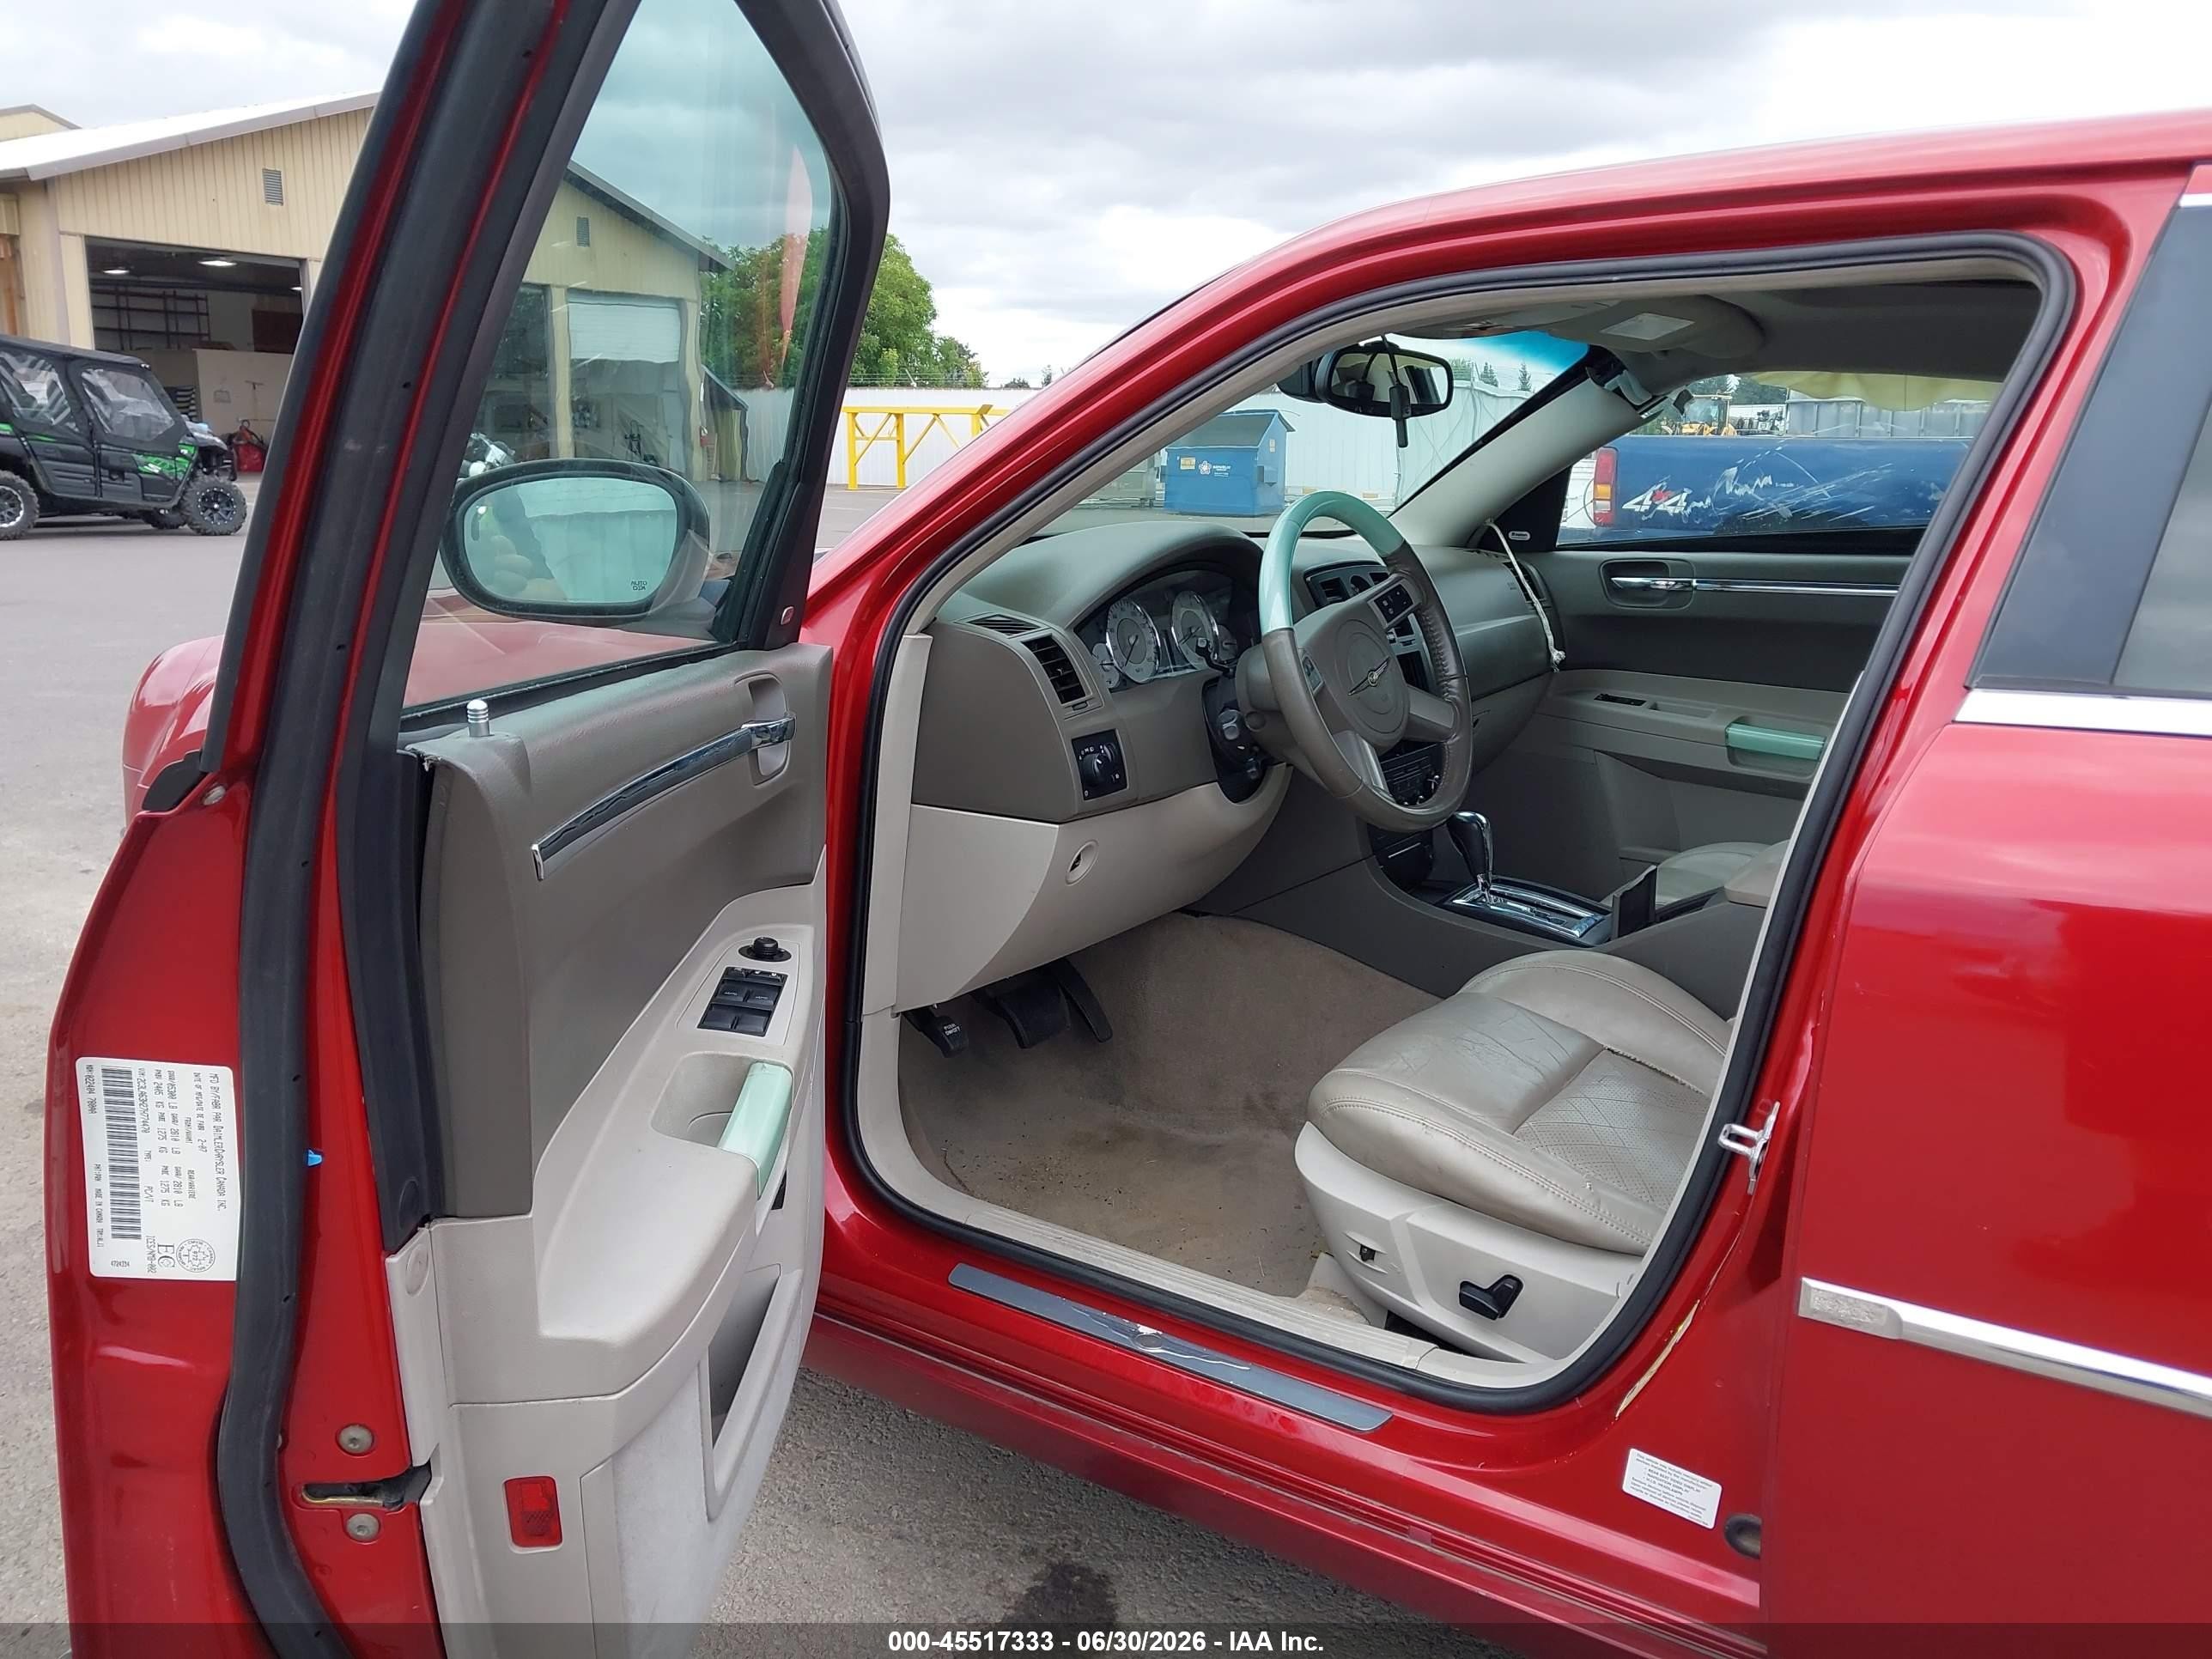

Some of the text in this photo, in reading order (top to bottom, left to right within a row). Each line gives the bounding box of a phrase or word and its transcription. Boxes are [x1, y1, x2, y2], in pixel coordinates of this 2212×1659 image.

[210, 1073, 220, 1084] MFD
[210, 1086, 221, 1109] BY/FABR
[213, 1112, 222, 1121] PAR
[157, 1128, 167, 1140] 1275
[198, 1139, 207, 1152] 2-07
[160, 1181, 169, 1193] 1275
[173, 1181, 182, 1194] 2810
[216, 1177, 227, 1196] CANADA
[217, 1200, 227, 1211] INC.
[157, 1243, 175, 1267] EC
